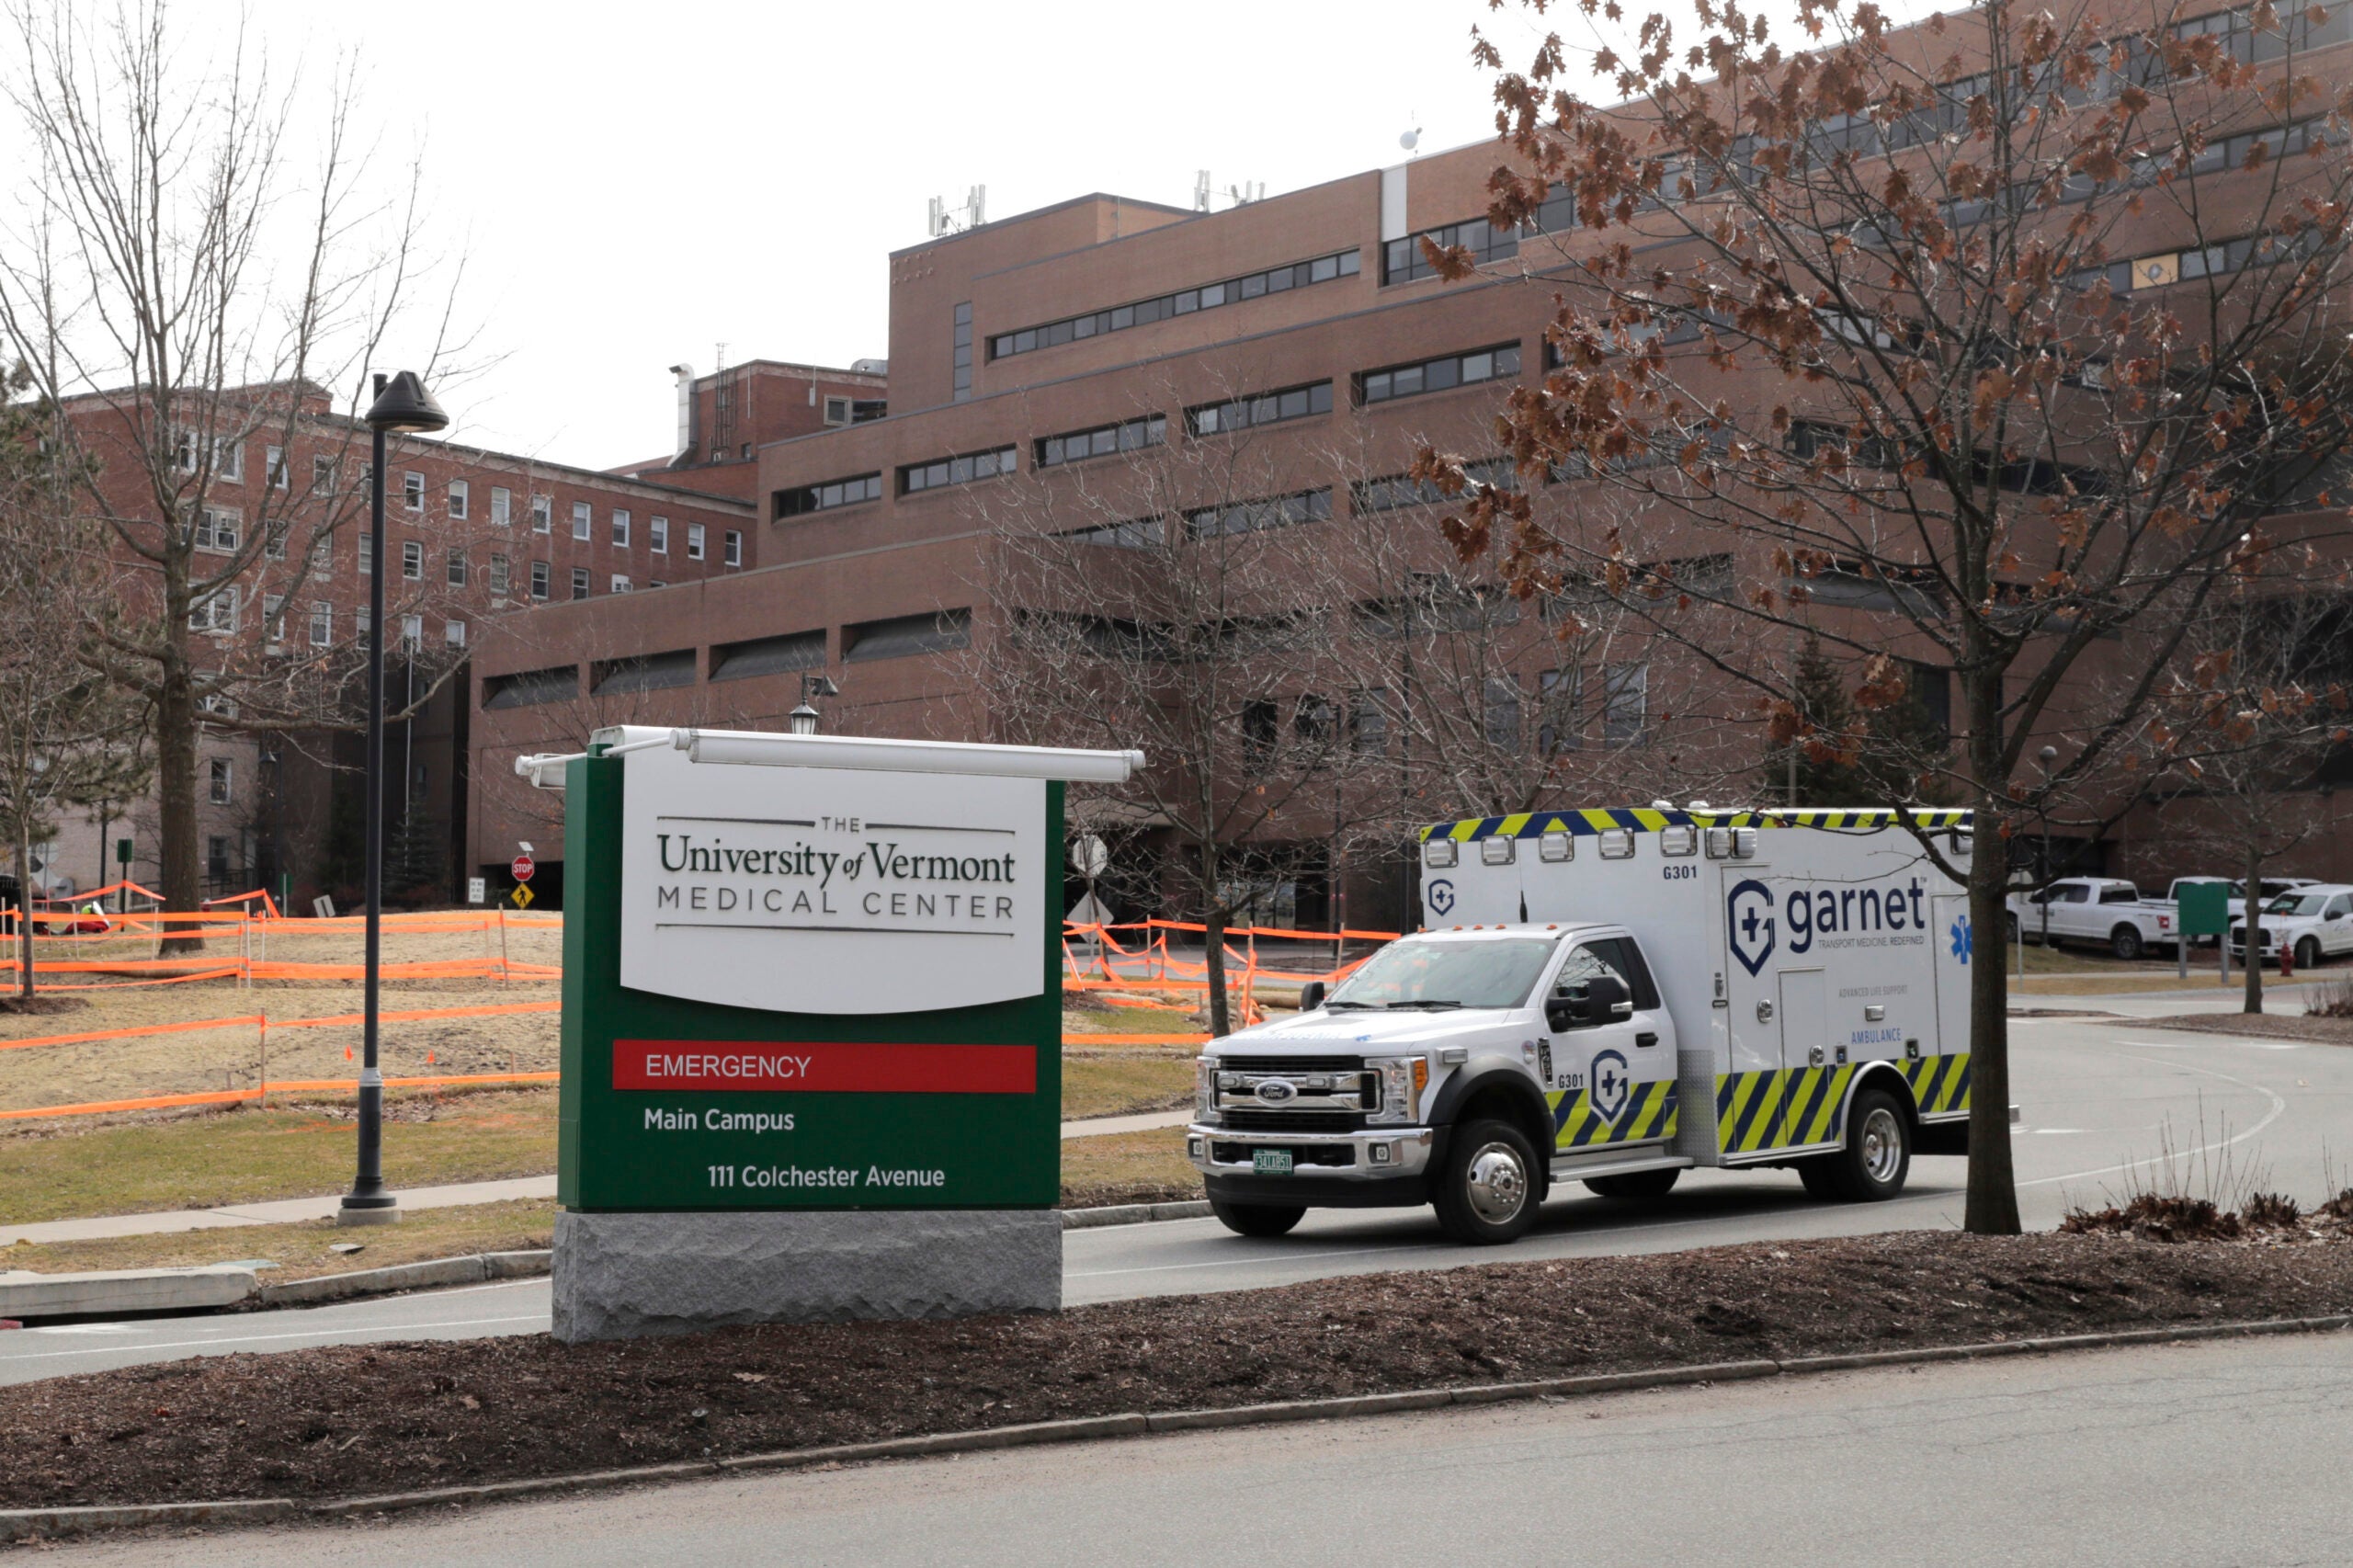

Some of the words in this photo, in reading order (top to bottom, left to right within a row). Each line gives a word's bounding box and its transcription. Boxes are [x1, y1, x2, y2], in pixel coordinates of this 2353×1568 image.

[821, 817, 859, 833] THE
[514, 864, 532, 873] STOP
[657, 834, 840, 890] University
[843, 852, 866, 881] of
[866, 842, 1015, 882] Vermont
[1664, 865, 1697, 880] G301
[658, 885, 837, 913] MEDICAL
[862, 892, 1013, 918] CENTER
[1787, 877, 1925, 953] garnet
[1818, 938, 1855, 949] TRANSPORT
[1890, 935, 1925, 946] REDEFINED
[1839, 985, 1869, 998] ADVANCED
[1870, 985, 1882, 996] LIFE
[1883, 984, 1907, 995] SUPPORT
[1851, 1028, 1901, 1044] AMBULANCE
[646, 1054, 812, 1078] EMERGENCY
[1558, 1074, 1584, 1088] G301
[644, 1108, 697, 1130] Main
[704, 1108, 794, 1134] Campus
[708, 1165, 734, 1187] 111
[742, 1165, 858, 1187] Colchester
[865, 1165, 945, 1187] Avenue
